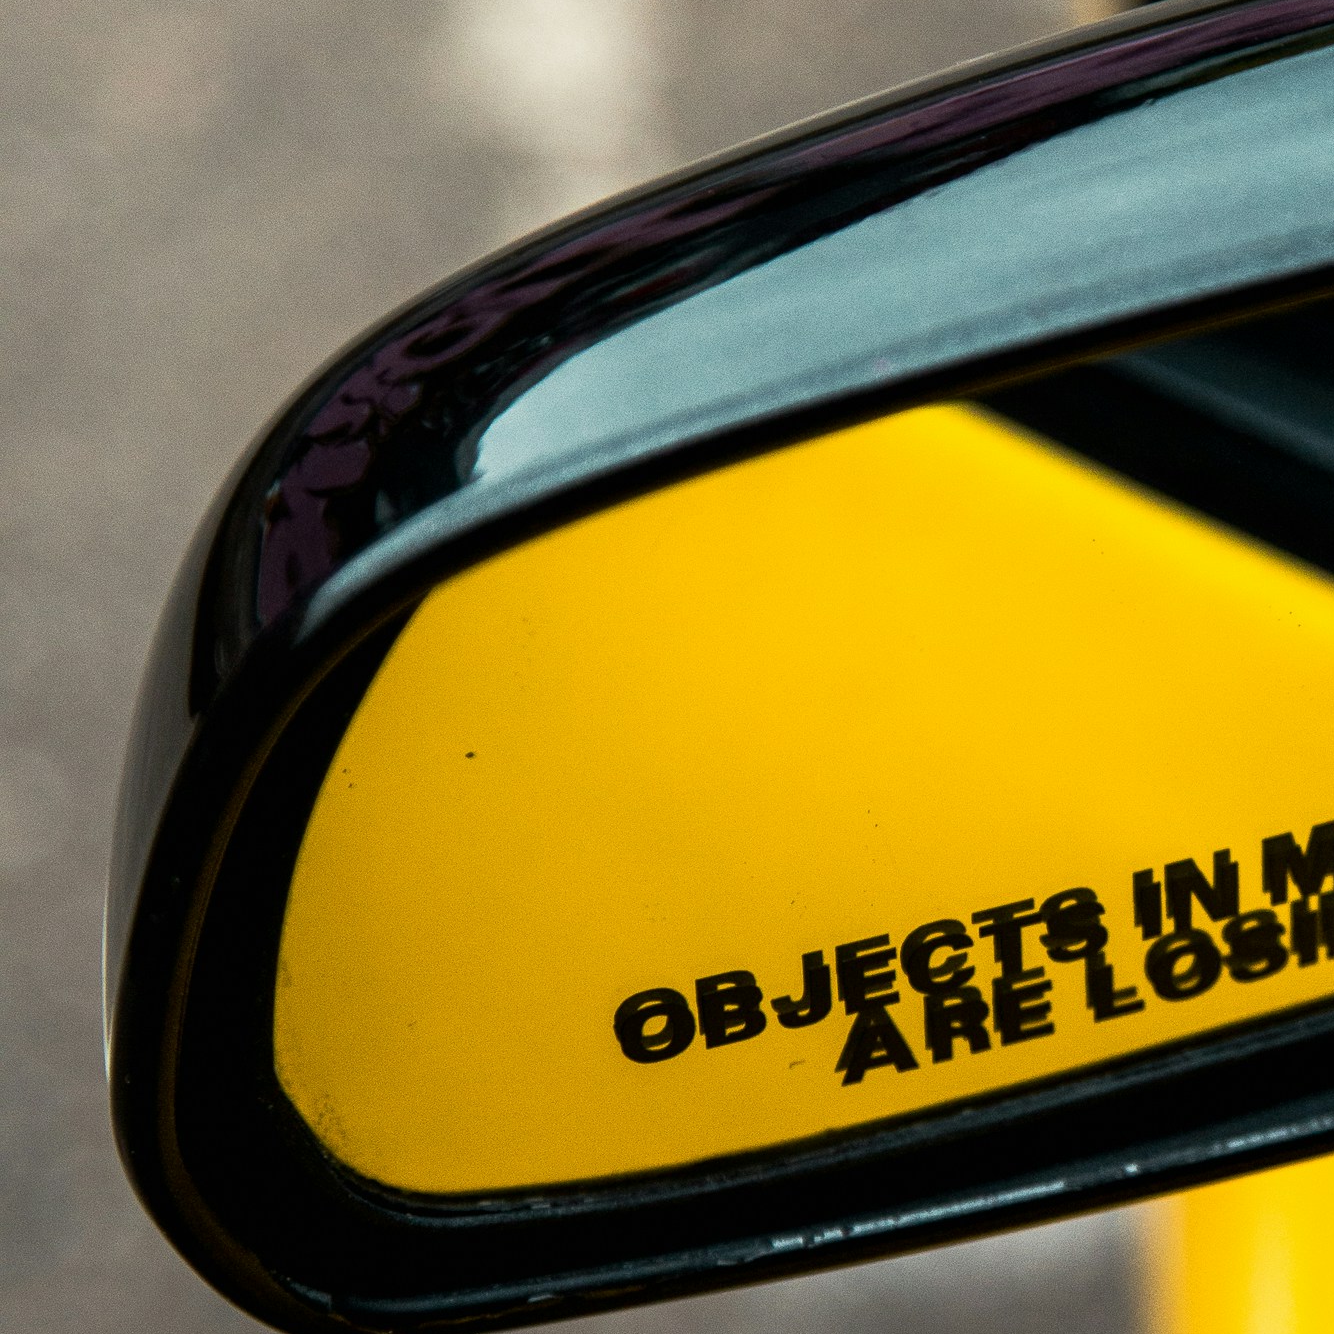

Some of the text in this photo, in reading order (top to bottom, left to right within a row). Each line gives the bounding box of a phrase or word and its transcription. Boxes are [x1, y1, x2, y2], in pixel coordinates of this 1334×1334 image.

[613, 886, 1110, 1065] OBJECTS
[1132, 849, 1243, 941] IN
[834, 966, 1057, 1087] ARE
